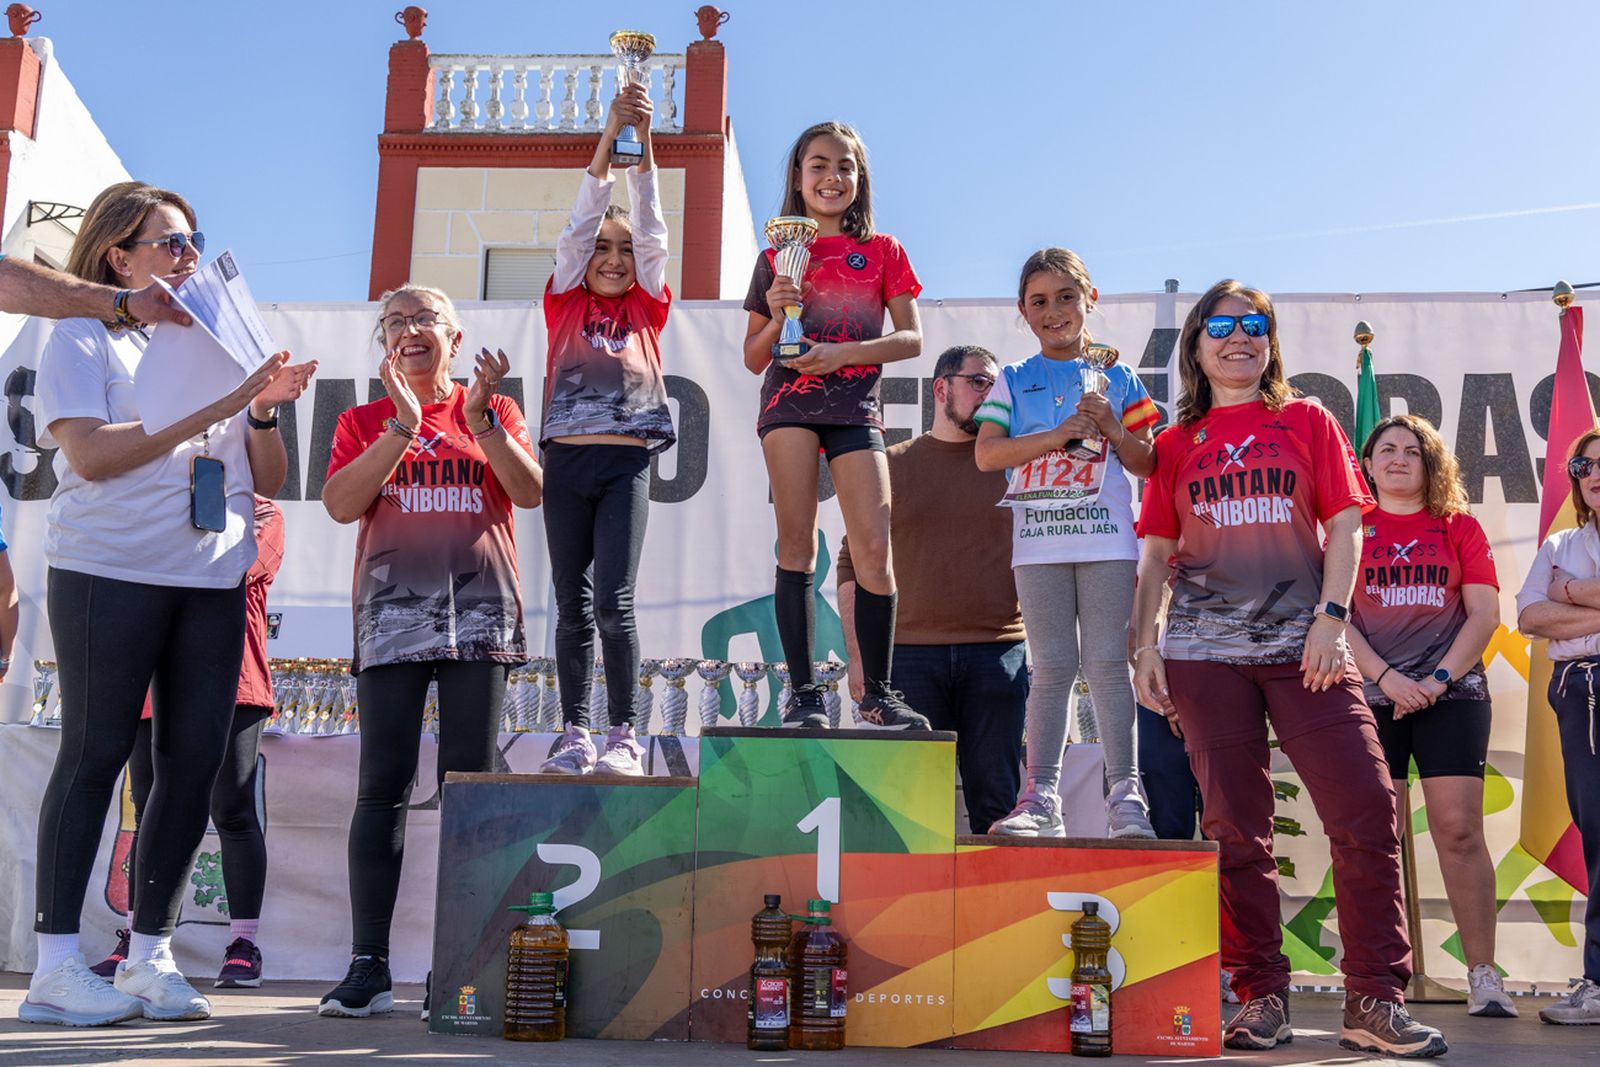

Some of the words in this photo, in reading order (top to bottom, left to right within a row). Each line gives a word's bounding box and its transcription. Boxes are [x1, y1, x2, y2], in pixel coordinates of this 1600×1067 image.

[1197, 442, 1281, 470] CROSS
[395, 459, 485, 486] ANTANO
[1022, 459, 1094, 489] 1124
[1188, 467, 1297, 505] PANTANO
[399, 482, 483, 514] VÍBORAS
[1192, 501, 1211, 516] DEL
[1020, 527, 1044, 538] CAJA
[1047, 524, 1087, 535] RURAL
[1090, 520, 1119, 534] JAÉN
[1372, 543, 1438, 559] CROSS
[1365, 564, 1449, 587] PANTANO
[1380, 583, 1446, 608] VÍBORAS
[797, 797, 841, 904] 1
[537, 843, 601, 950] 2
[855, 992, 946, 1006] DEPORTES
